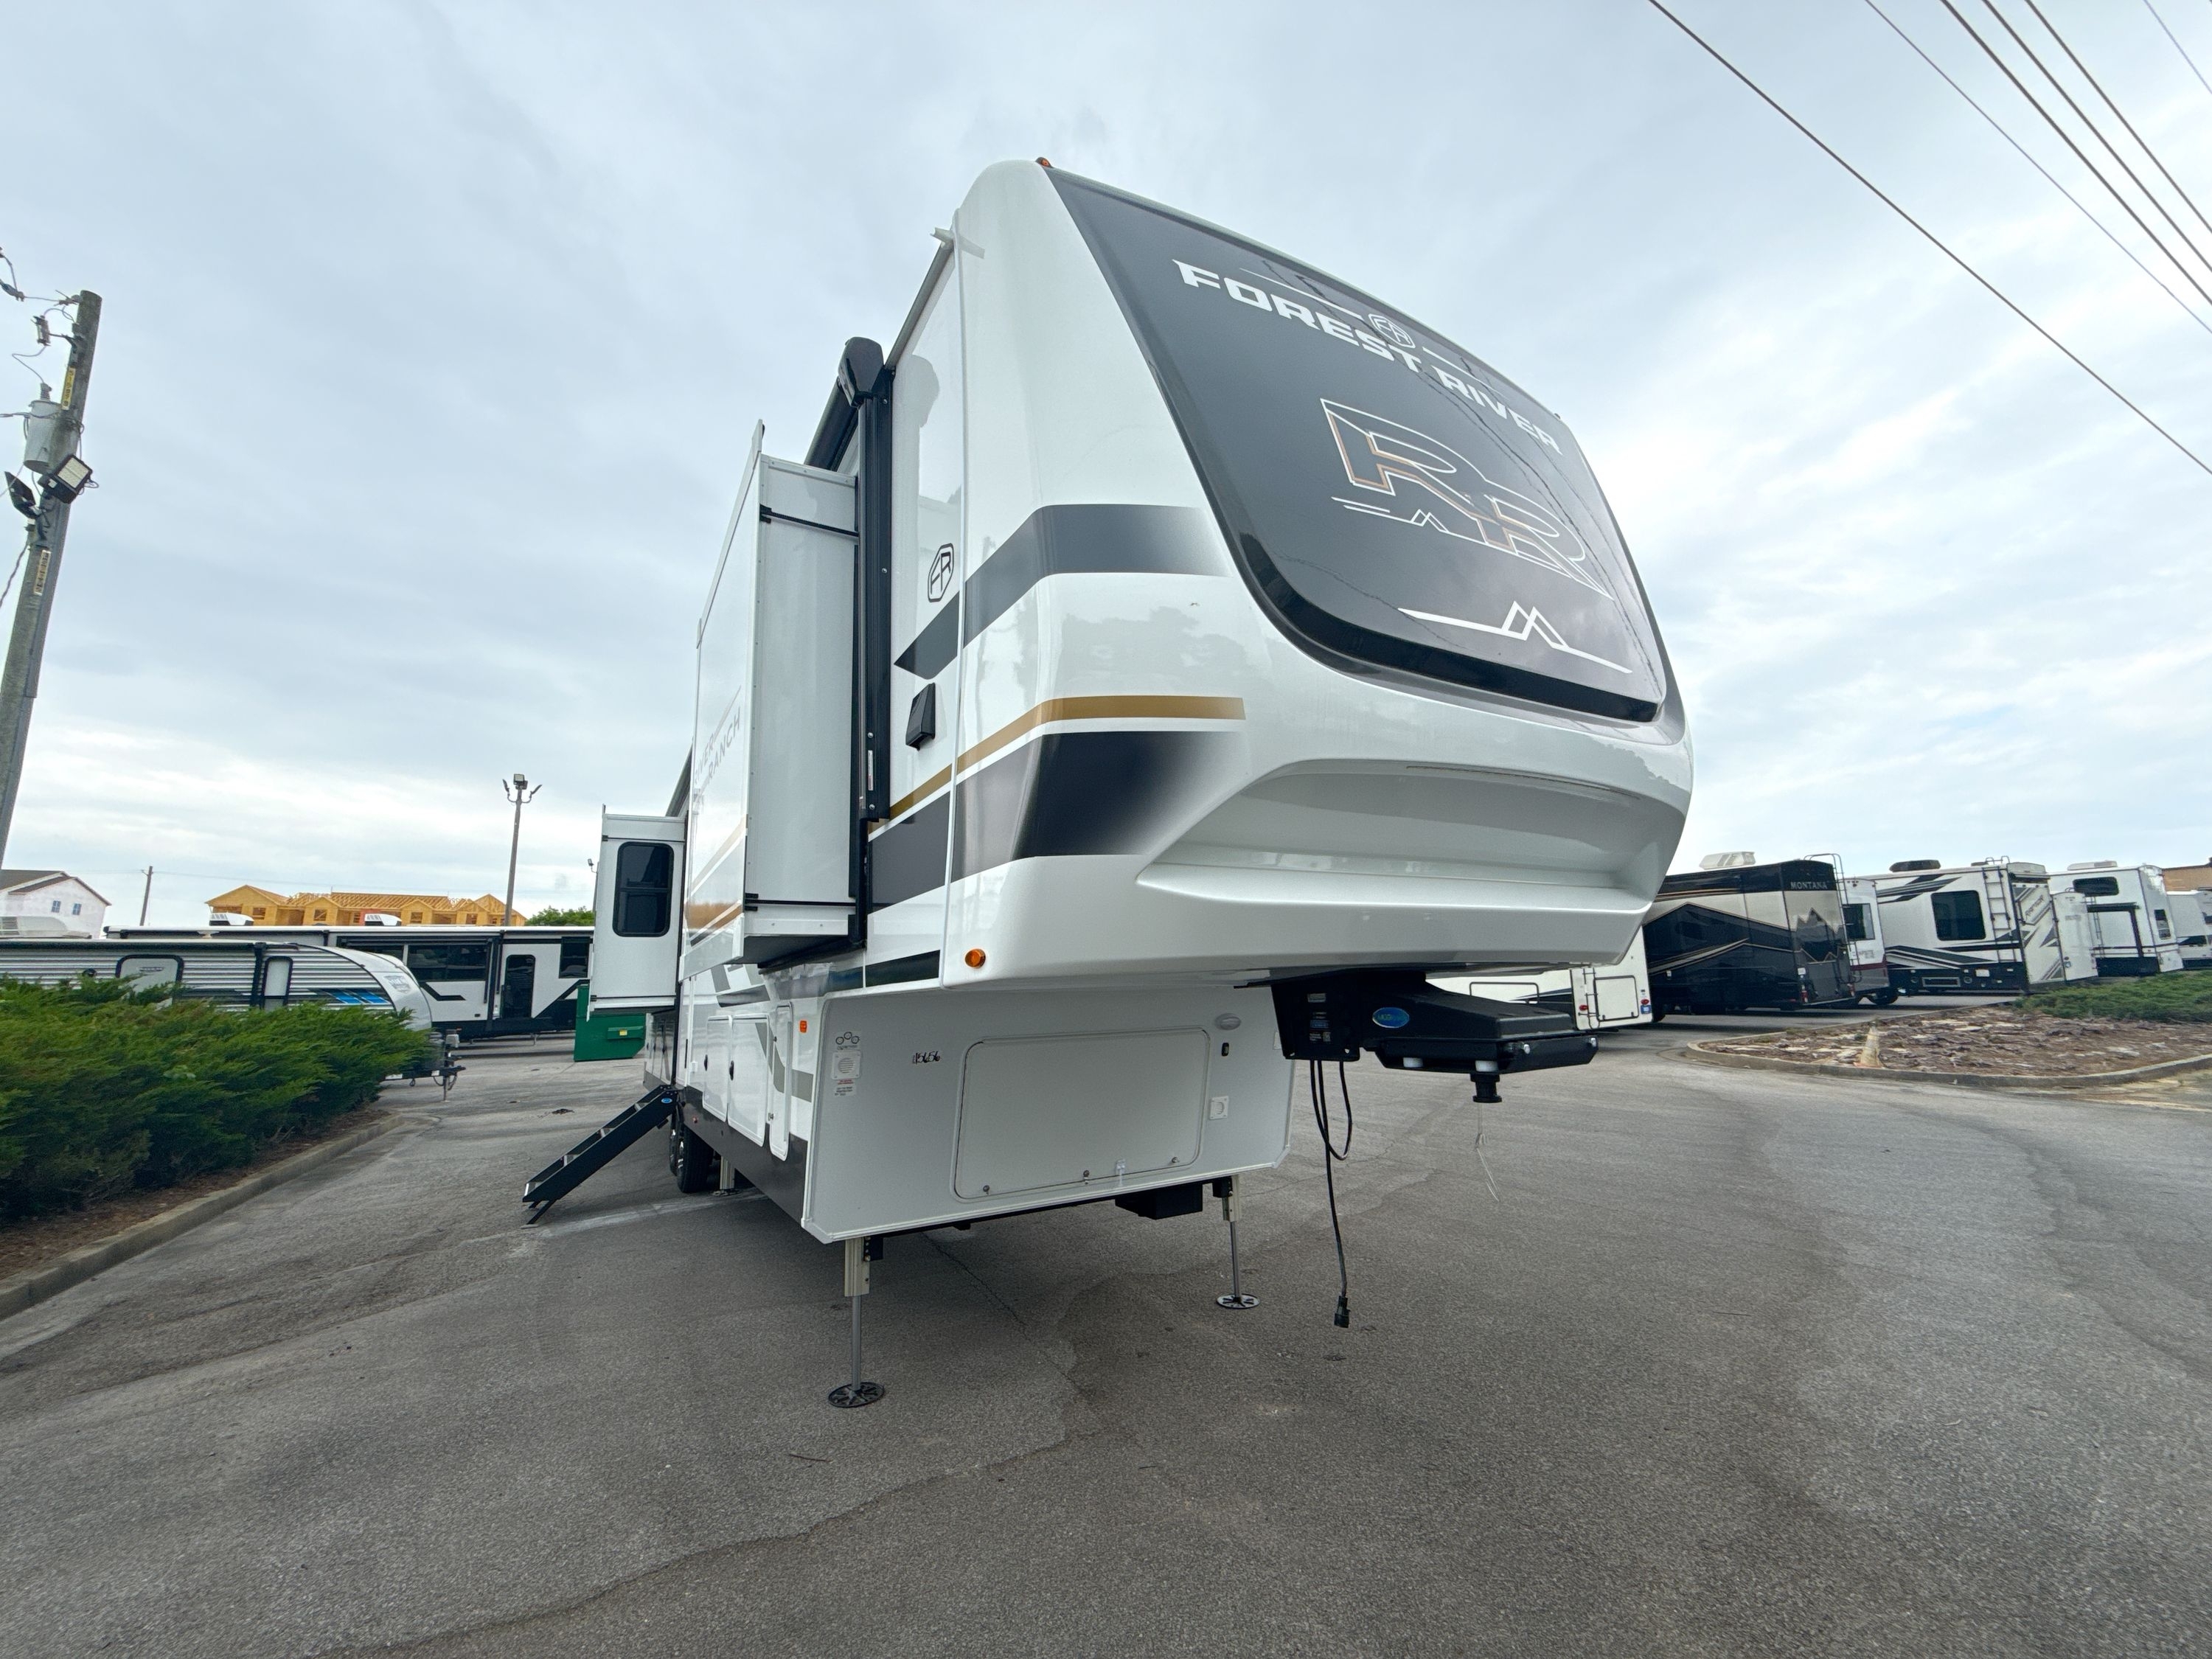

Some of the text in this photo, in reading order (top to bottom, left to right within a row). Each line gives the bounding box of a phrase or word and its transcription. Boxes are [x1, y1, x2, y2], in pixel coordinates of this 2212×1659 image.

[1172, 260, 1563, 455] FOREST RIVER
[695, 733, 714, 785] RIVER
[708, 706, 740, 785] RANCH
[1790, 881, 1828, 890] MONTANA
